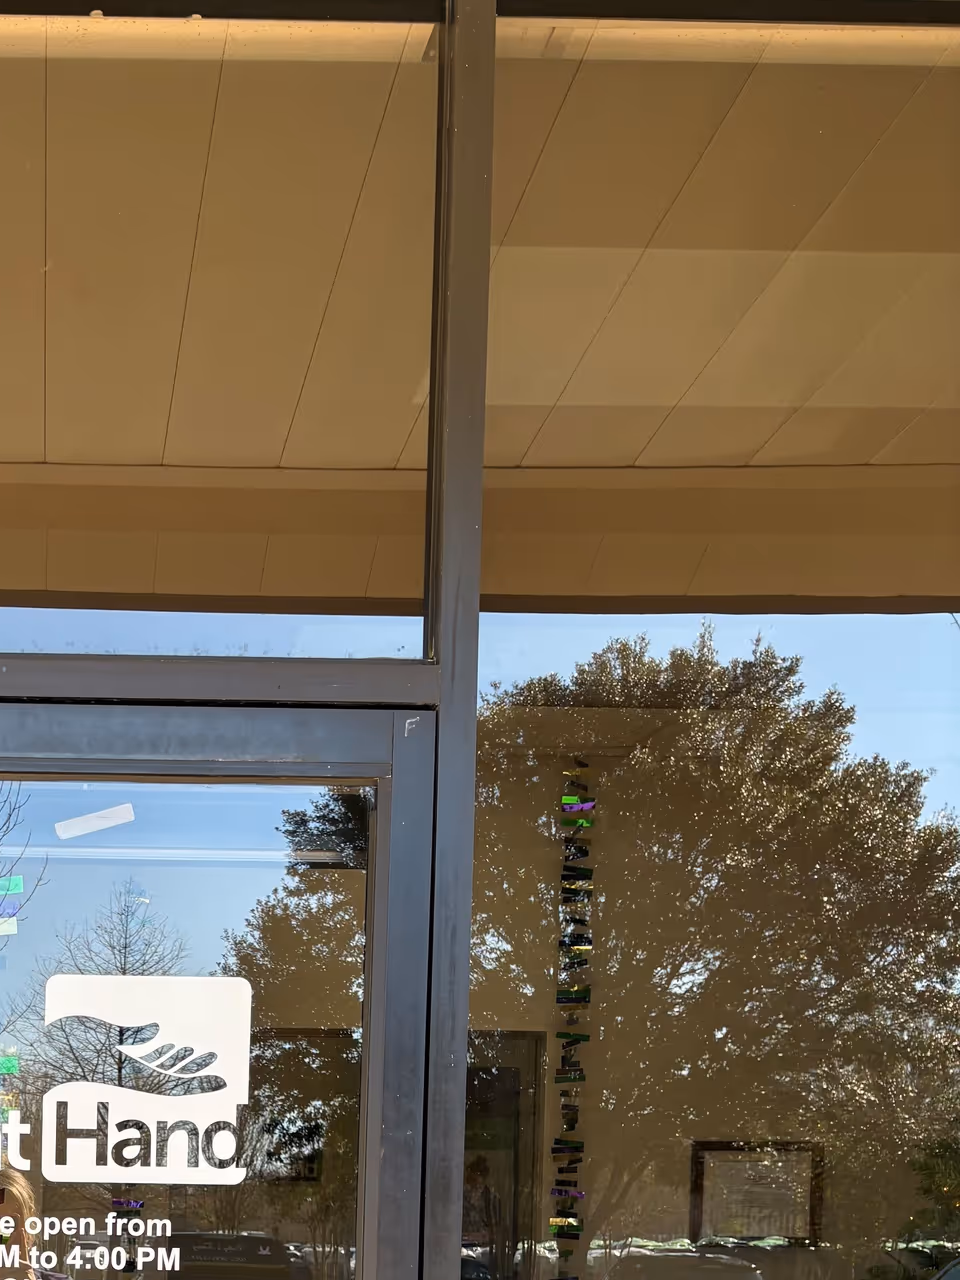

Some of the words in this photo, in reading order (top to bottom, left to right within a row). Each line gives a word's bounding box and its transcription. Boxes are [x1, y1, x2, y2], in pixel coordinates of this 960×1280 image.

[55, 1101, 248, 1170] Hand
[24, 1216, 96, 1241] open
[104, 1211, 172, 1237] from
[29, 1246, 58, 1269] to
[66, 1246, 127, 1271] 4:00
[137, 1246, 180, 1271] PM
